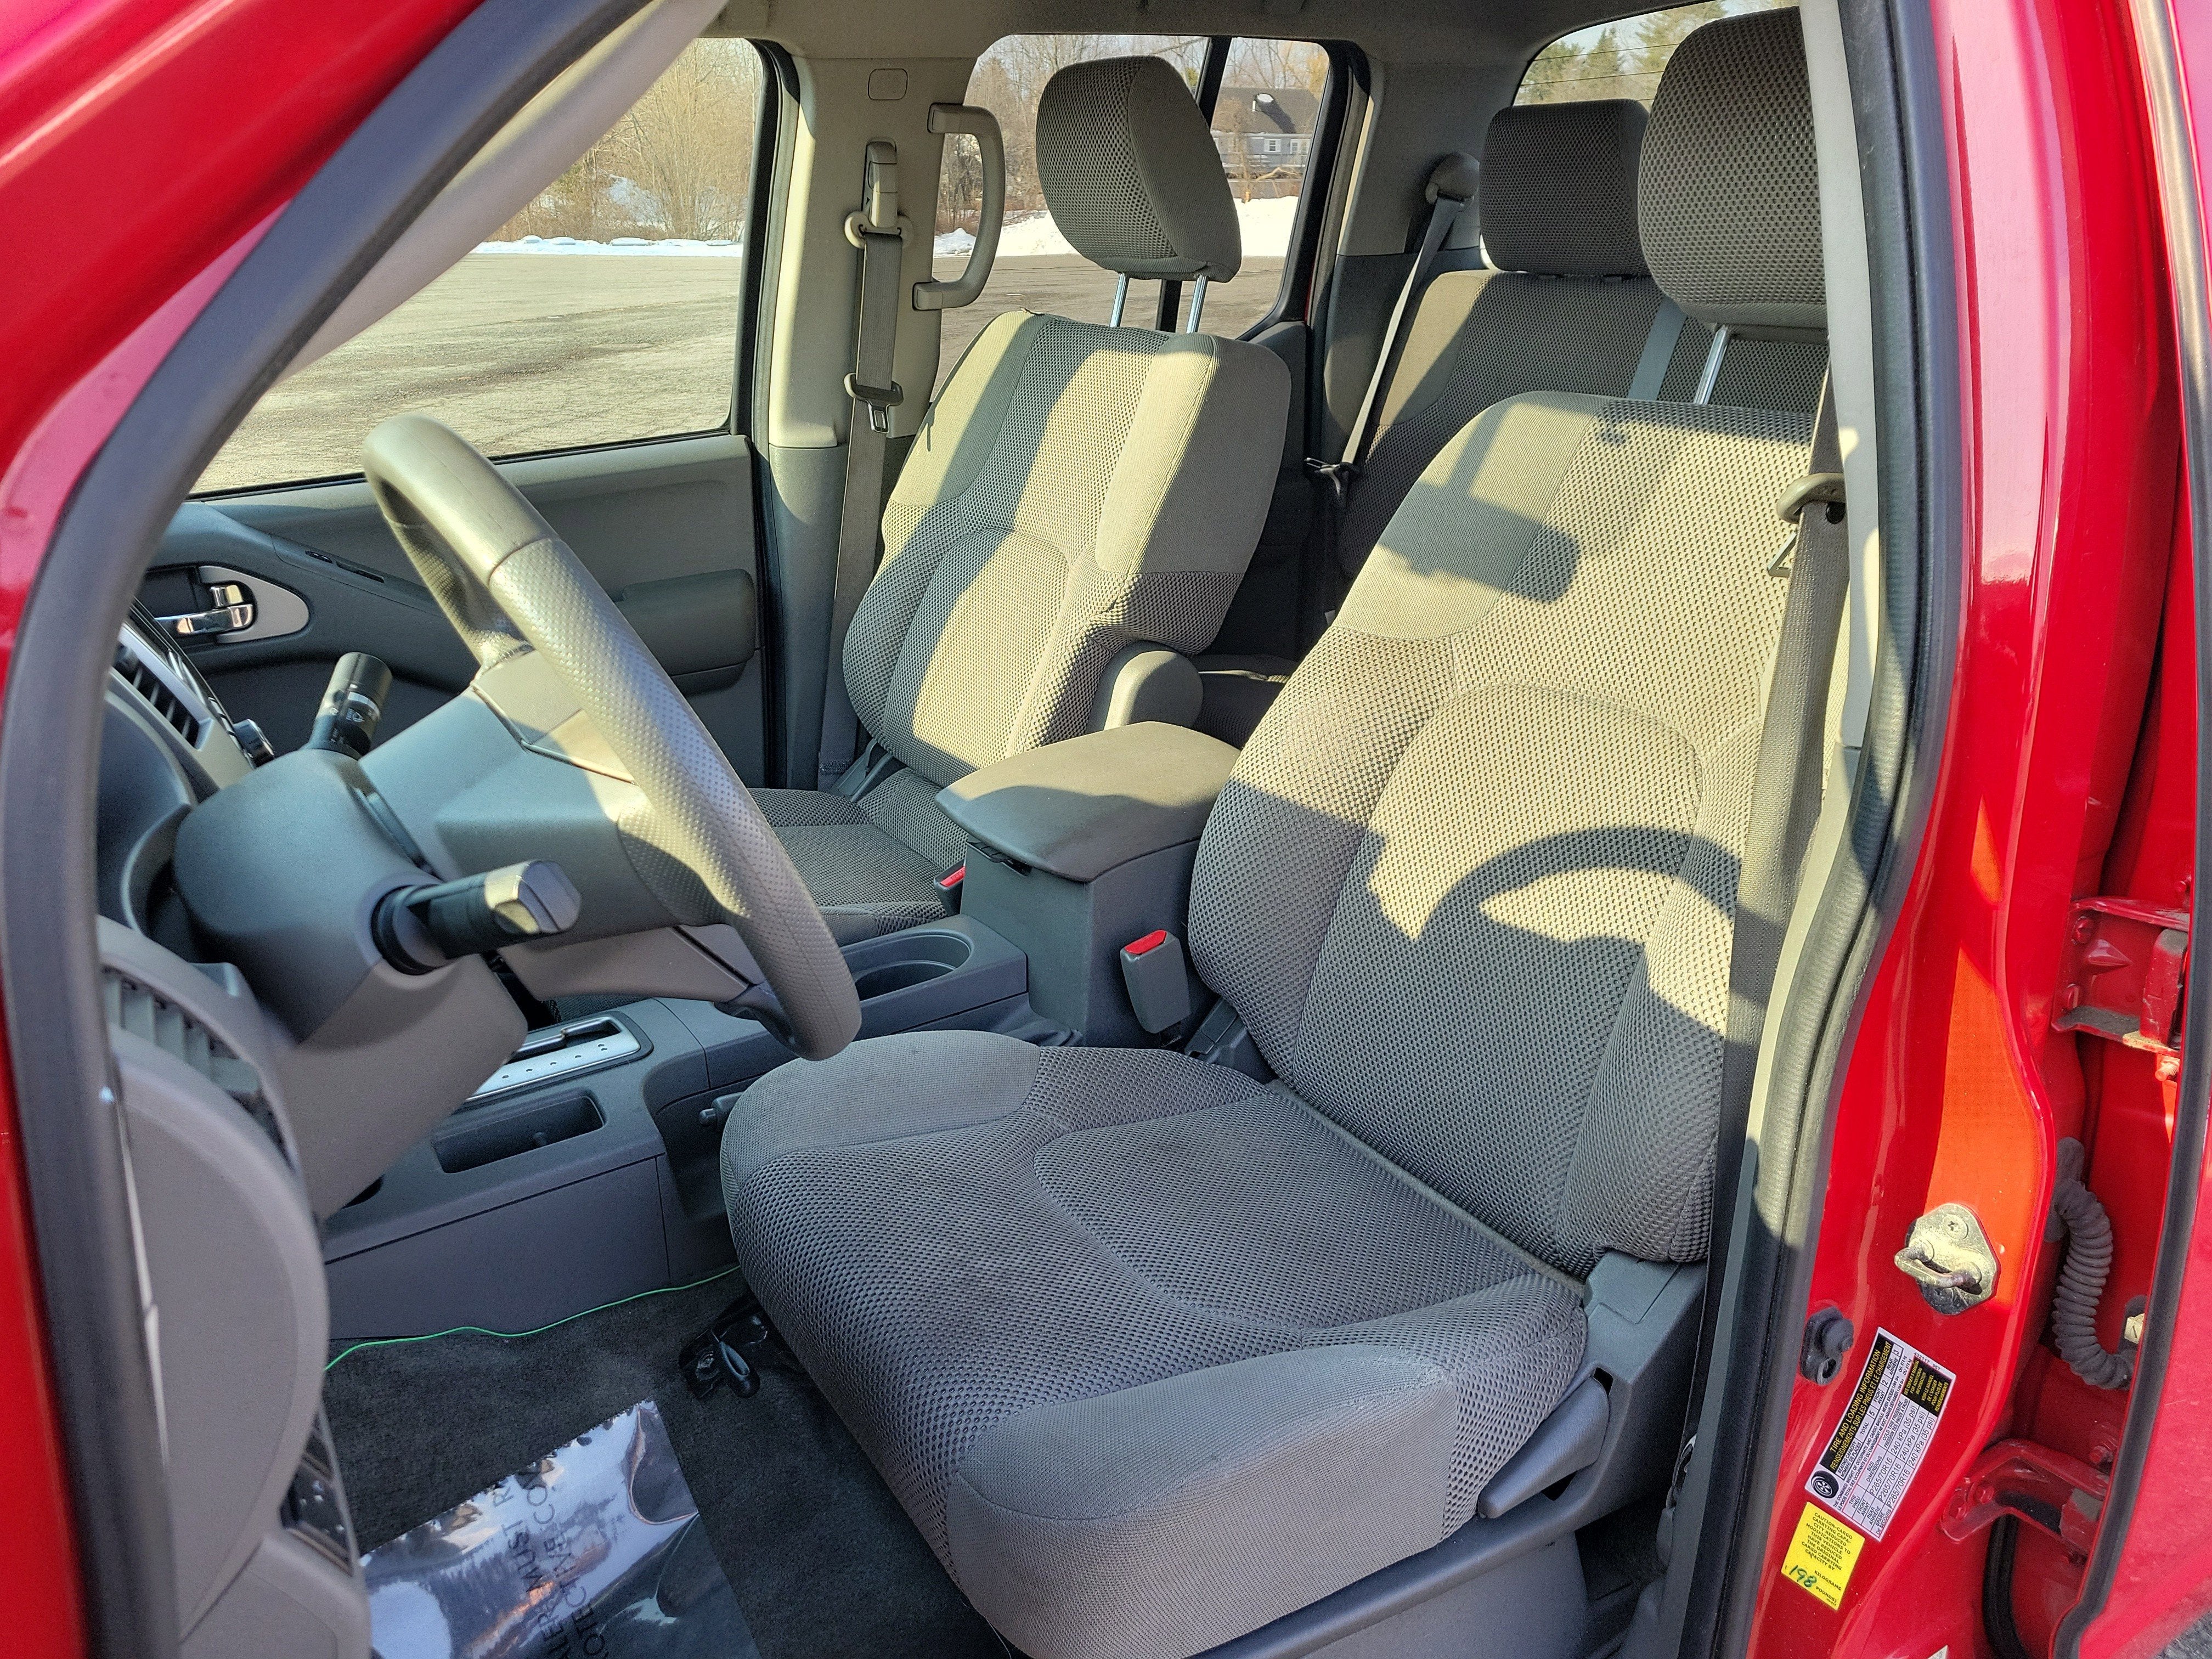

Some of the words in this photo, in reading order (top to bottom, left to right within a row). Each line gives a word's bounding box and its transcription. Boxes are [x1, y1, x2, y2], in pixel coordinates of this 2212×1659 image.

[1876, 1341, 1891, 1375] CHARGEMENT
[1870, 1381, 1876, 1389] ET
[1872, 1374, 1880, 1383] LE
[1913, 1368, 1922, 1386] ADDITIONAL
[1916, 1372, 1926, 1394] INFORMATION
[1830, 1437, 1842, 1452] TIRE
[1839, 1423, 1849, 1438] AND
[1846, 1393, 1863, 1423] LOADING
[1860, 1350, 1880, 1393] INFORMATION
[1863, 1388, 1874, 1406] PNEUS
[1853, 1415, 1862, 1426] SUR
[1858, 1405, 1866, 1416] LES
[1892, 1401, 1903, 1421] PRESSURE
[1860, 1423, 1869, 1435] TOTAL
[1884, 1431, 1894, 1448] PRESSION
[1891, 1441, 1900, 1454] 240
[1897, 1429, 1906, 1441] kPa
[1903, 1417, 1913, 1430] (35
[1909, 1406, 1918, 1419] psi)
[1900, 1447, 1909, 1460] 240
[1905, 1435, 1915, 1447] kPa
[1912, 1423, 1920, 1435] (35
[1917, 1412, 1926, 1424] psi)
[1830, 1426, 1856, 1469] RENSEIGNEMENTS
[1909, 1453, 1918, 1466] 240
[1914, 1441, 1924, 1453] kPa
[1921, 1429, 1929, 1441] (35
[1926, 1417, 1935, 1430] psi)
[1837, 1483, 1848, 1500] COMBINED
[1846, 1470, 1855, 1483] WEIGHT
[1856, 1446, 1868, 1465] OCCUPANTS
[1876, 1413, 1884, 1426] SHOULD
[1838, 1458, 1848, 1474] SEATING
[1846, 1441, 1857, 1458] CAPACITY
[1841, 1462, 1851, 1477] NOMBRE
[1852, 1442, 1861, 1457] PLACES
[1854, 1462, 1865, 1480] OCCUPANTS
[1869, 1431, 1881, 1452] CHARGEMENT
[1866, 1455, 1882, 1482] DIMENSIONS
[1870, 1458, 1892, 1495] P265/70R16
[1878, 1463, 1901, 1501] P265/70R16
[1887, 1469, 1910, 1507] P265/70R16
[1852, 1496, 1860, 1509] PNEU
[1857, 1498, 1866, 1514] FRONT
[1861, 1502, 1870, 1516] AVANT
[1867, 1506, 1875, 1519] REAR
[1813, 1517, 1836, 1534] CARRYING
[1837, 1533, 1850, 1543] CAPA-
[1815, 1513, 1852, 1539] CAUTION-CARGO
[1876, 1512, 1884, 1526] SPARE
[1880, 1509, 1893, 1528] SECOURS
[1807, 1523, 1843, 1549] MODIFICATIONS
[1812, 1531, 1822, 1541] THIS
[1823, 1539, 1842, 1554] VEHICLE
[1814, 1522, 1824, 1531] CITY
[1825, 1531, 1846, 1546] REDUCED
[501, 1519, 549, 1593] MUST
[1802, 1542, 1817, 1553] CARGO
[1818, 1553, 1842, 1570] CARRYING
[1805, 1549, 1827, 1565] CAPACITY
[1808, 1535, 1820, 1545] HAVE
[1821, 1544, 1842, 1559] REDUCED
[1816, 1547, 1838, 1564] ORIGINAL
[1790, 1565, 1816, 1587] 198
[1815, 1571, 1841, 1590] KILOGRAMS
[1816, 1586, 1836, 1602] POUNDS)
